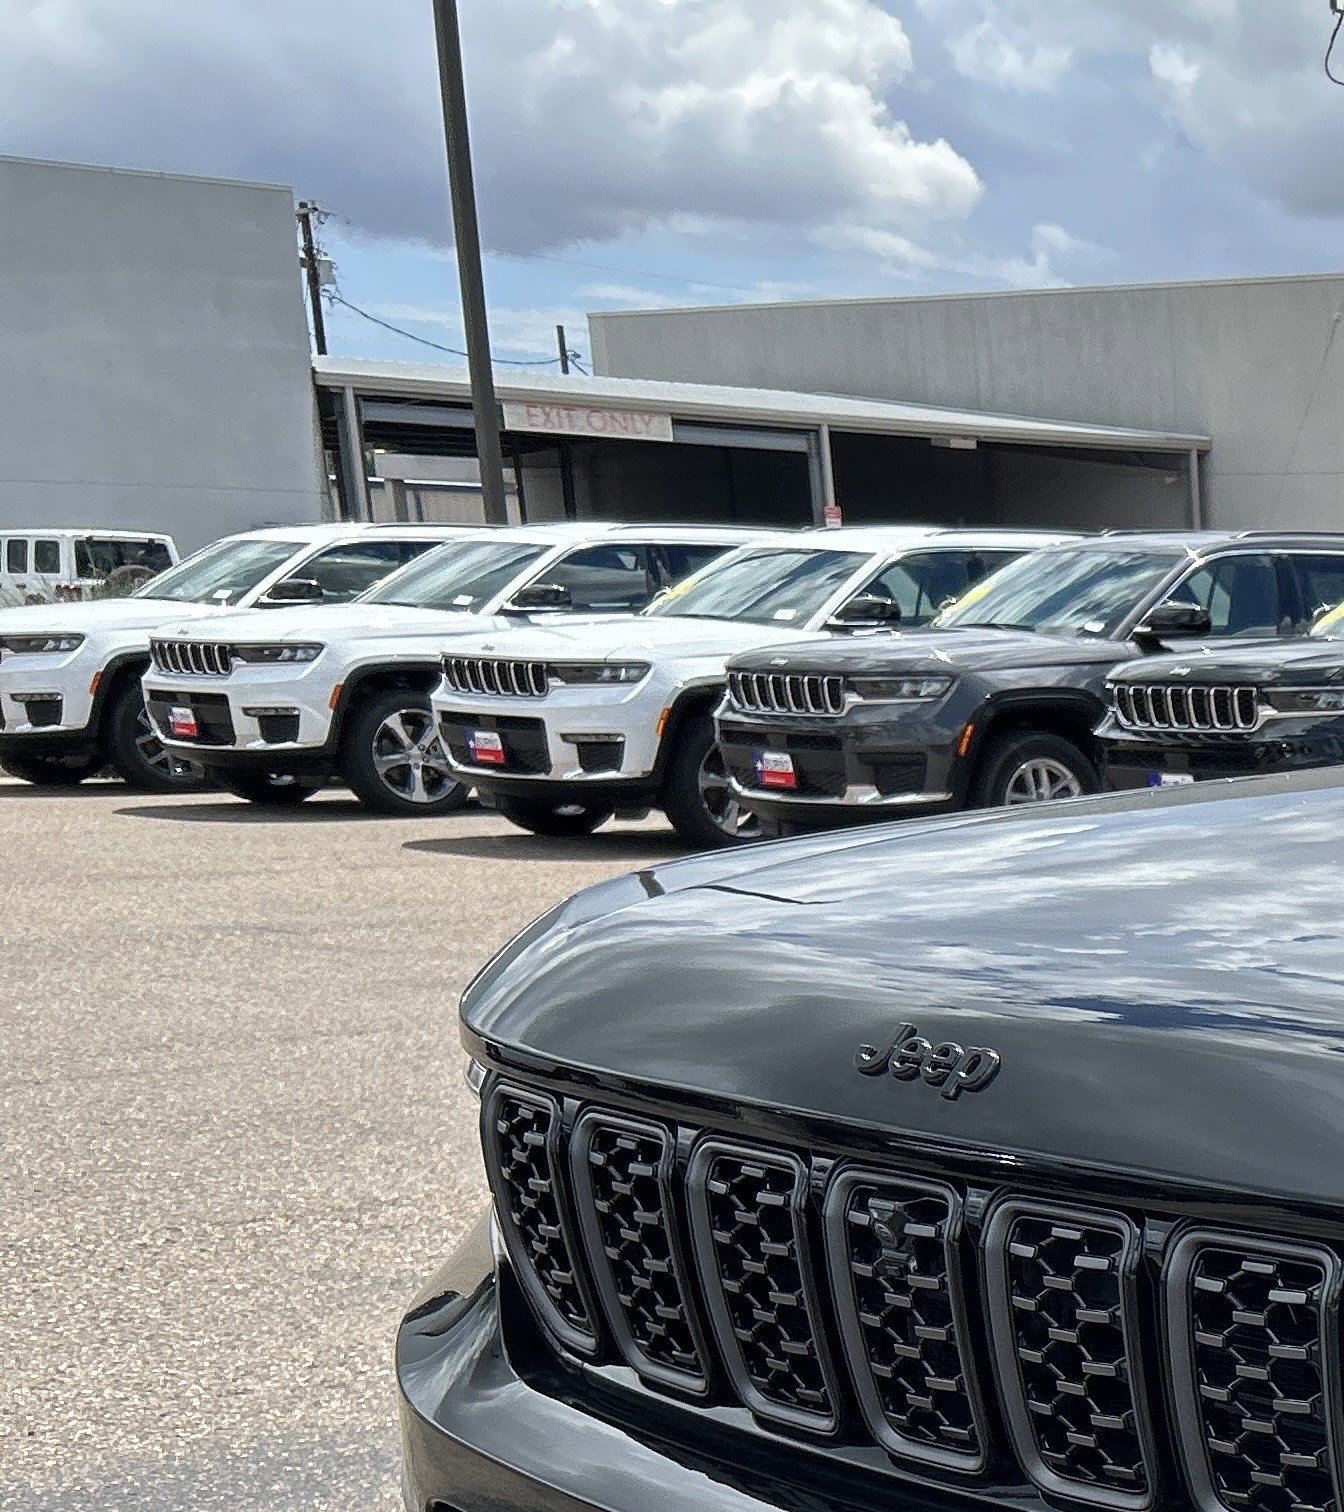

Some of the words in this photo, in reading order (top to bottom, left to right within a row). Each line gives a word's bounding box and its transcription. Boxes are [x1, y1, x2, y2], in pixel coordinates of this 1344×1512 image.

[526, 403, 577, 431] EXIT
[586, 407, 652, 435] ONLY
[853, 1021, 1001, 1101] Jeep
